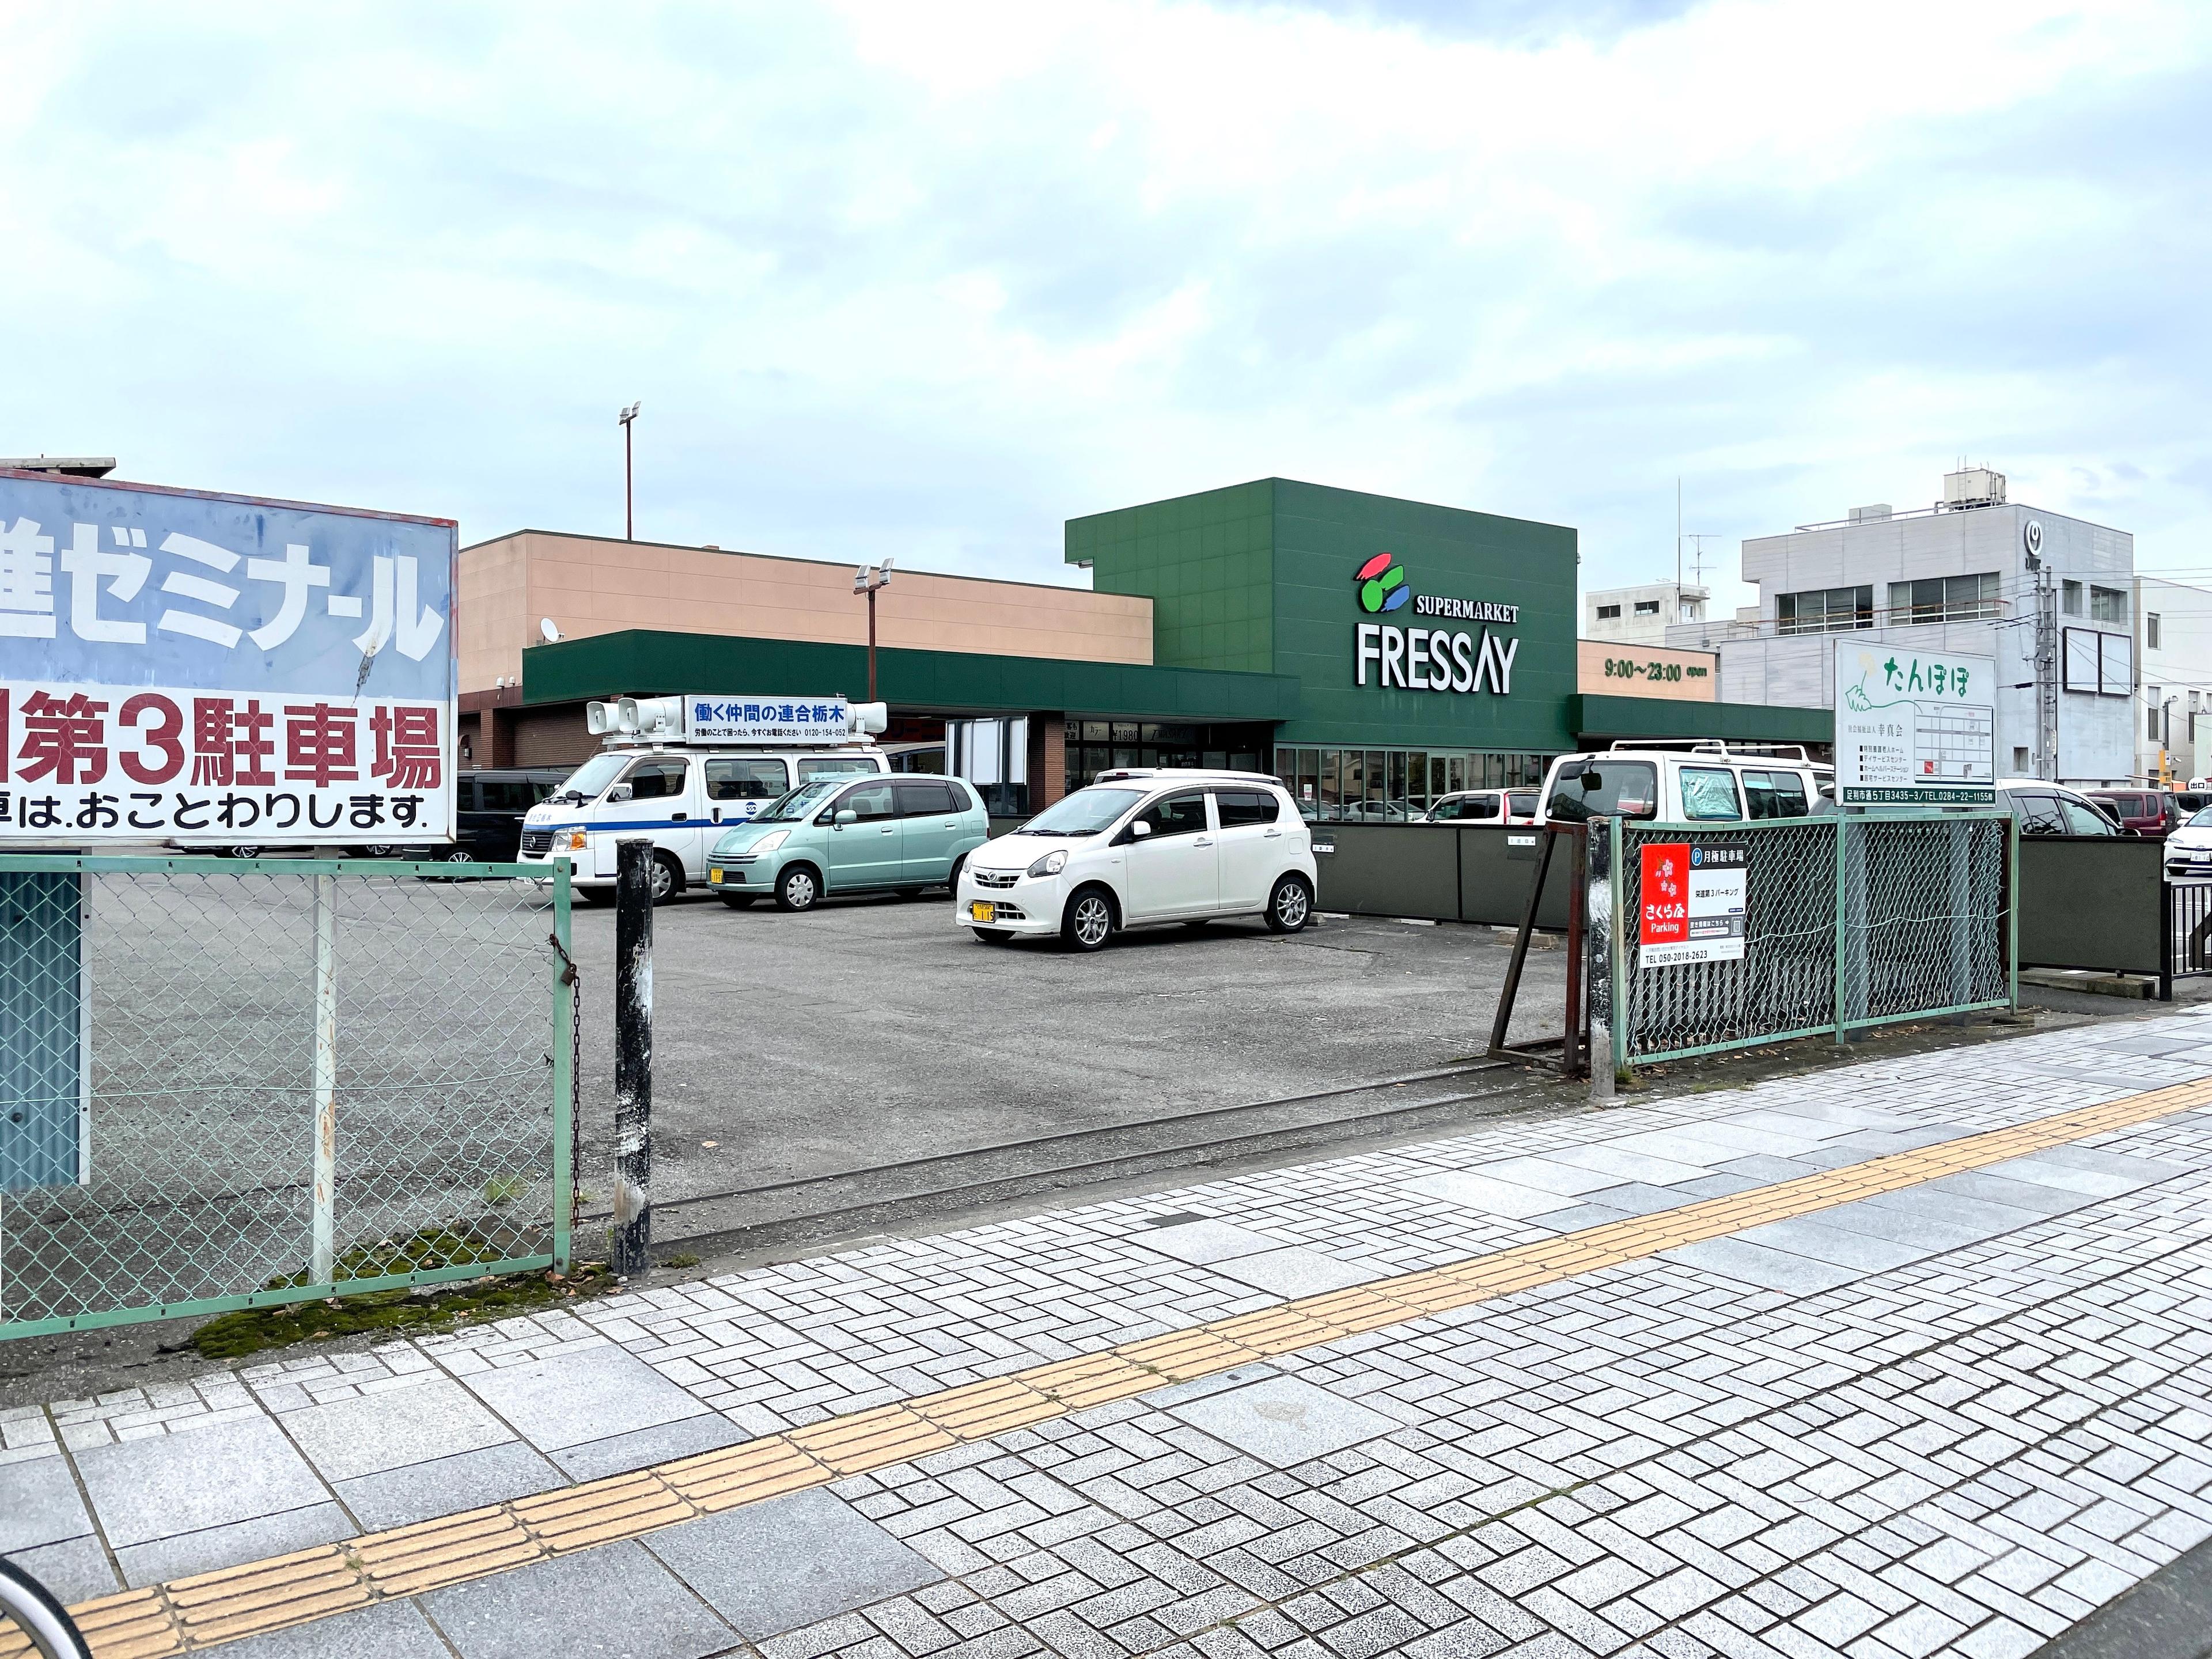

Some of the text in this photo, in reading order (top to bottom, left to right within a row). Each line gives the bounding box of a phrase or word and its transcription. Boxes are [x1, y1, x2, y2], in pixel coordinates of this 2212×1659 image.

[1416, 595, 1520, 623] SUPERMARKET
[1357, 623, 1520, 694] FRESSAY
[1687, 666, 1707, 677] open
[1884, 657, 1969, 698] たんぽぽ
[695, 703, 845, 723] 働く仲間の連合栃木
[0, 688, 442, 789] 第3駐車場
[805, 729, 846, 737] 0120-154-052
[1703, 849, 1744, 863] 月極駐車場
[1645, 903, 1685, 920] さくら屋
[1651, 923, 1679, 934] Parking
[1646, 950, 1708, 964] TEL 050-2018-2623
